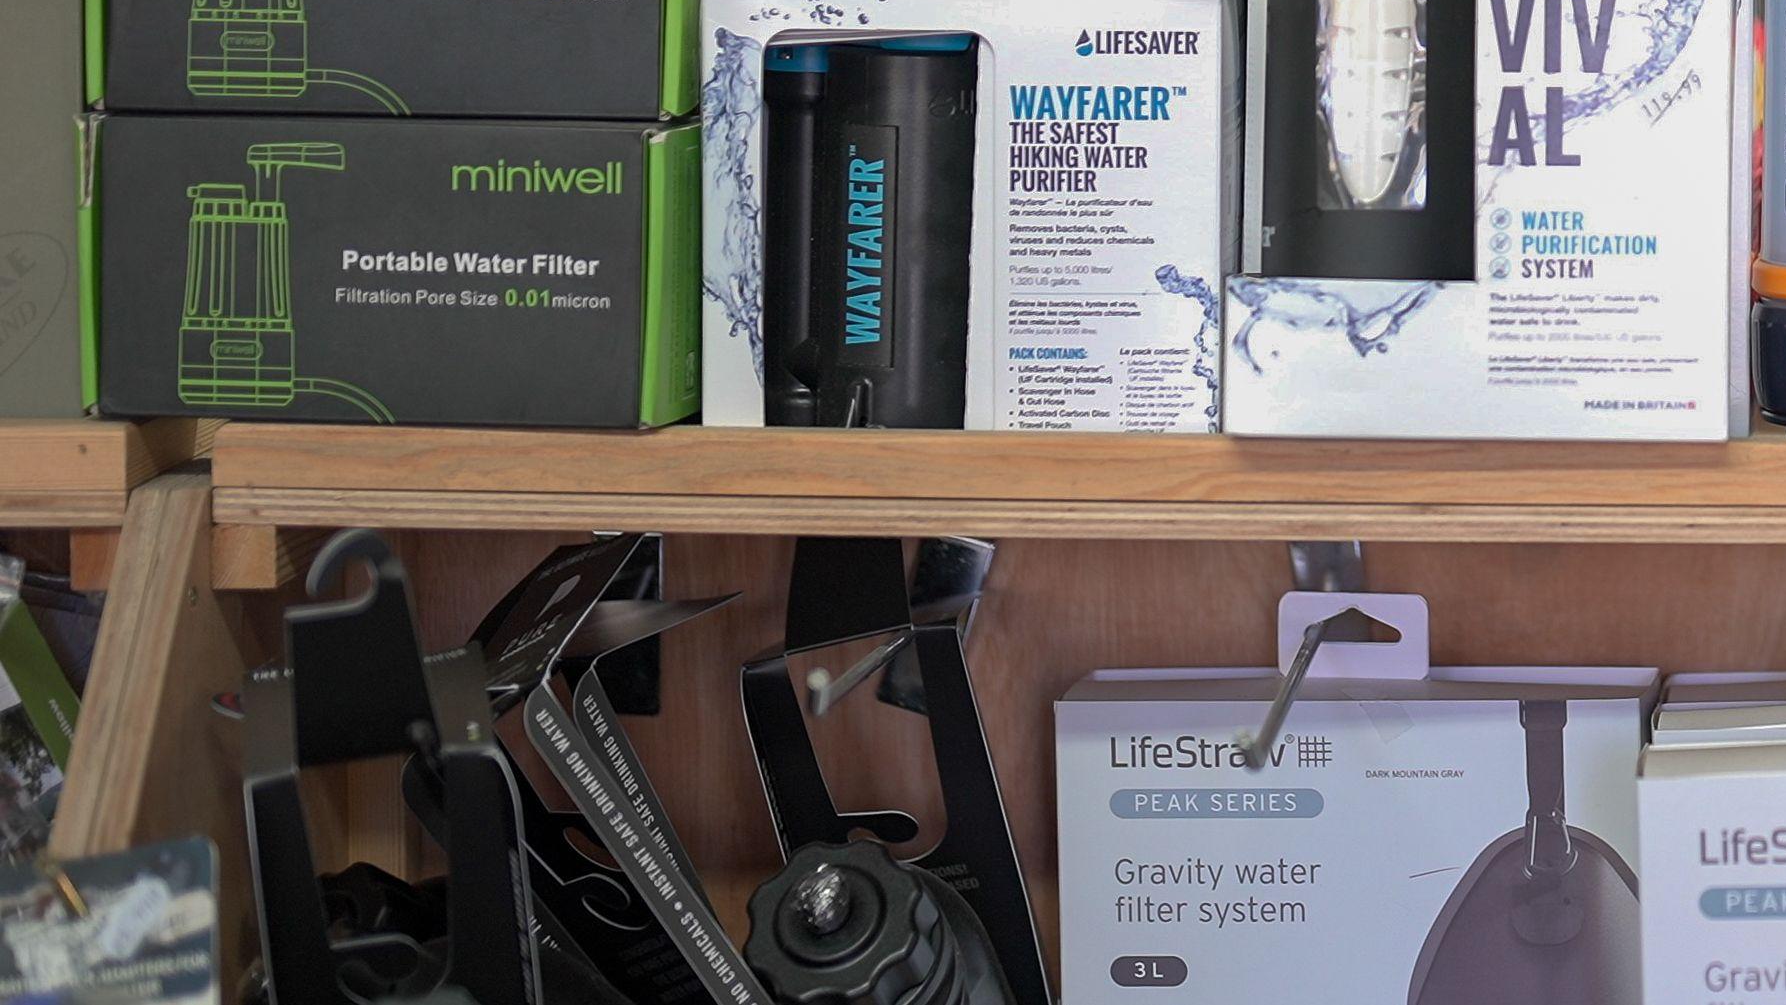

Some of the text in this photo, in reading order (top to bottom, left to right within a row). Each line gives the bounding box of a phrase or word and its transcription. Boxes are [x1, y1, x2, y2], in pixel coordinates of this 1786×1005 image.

[1096, 31, 1200, 55] LIFESAVER
[1009, 122, 1120, 144] THE SAFEST
[1488, 87, 1582, 166] AL
[1009, 146, 1148, 168] HIKING WATER
[452, 161, 623, 195] miniwell
[1009, 170, 1097, 192] PURIFIER
[1009, 224, 1053, 233] Removes
[1521, 211, 1584, 231] WATER
[1009, 236, 1155, 245] viruses and reduces chemicals
[1521, 235, 1658, 255] PURIFICATION
[342, 249, 599, 277] Portable Water Filter
[1009, 248, 1092, 258] and heavy metals
[1521, 259, 1594, 279] SYSTEM
[335, 287, 411, 305] Filtration
[415, 288, 455, 305] Pore
[460, 289, 498, 307] Size
[1009, 348, 1035, 360] PACK
[1585, 400, 1619, 410] MADE
[582, 694, 610, 738] WATER
[535, 708, 571, 755] WATER
[603, 735, 641, 796] DRINKING
[1365, 770, 1464, 778] DARK MOUNTAIN GRAY
[566, 755, 614, 815] DRINKING
[632, 793, 656, 829] SAFE
[1135, 793, 1298, 812] PEAK SERIES
[609, 811, 641, 849] SAFE
[633, 847, 677, 902] INSTANT
[1114, 858, 1321, 891] Gravity water
[1115, 897, 1306, 929] filter system
[680, 910, 737, 985] CHEMICALS
[1134, 963, 1164, 979] 3 L
